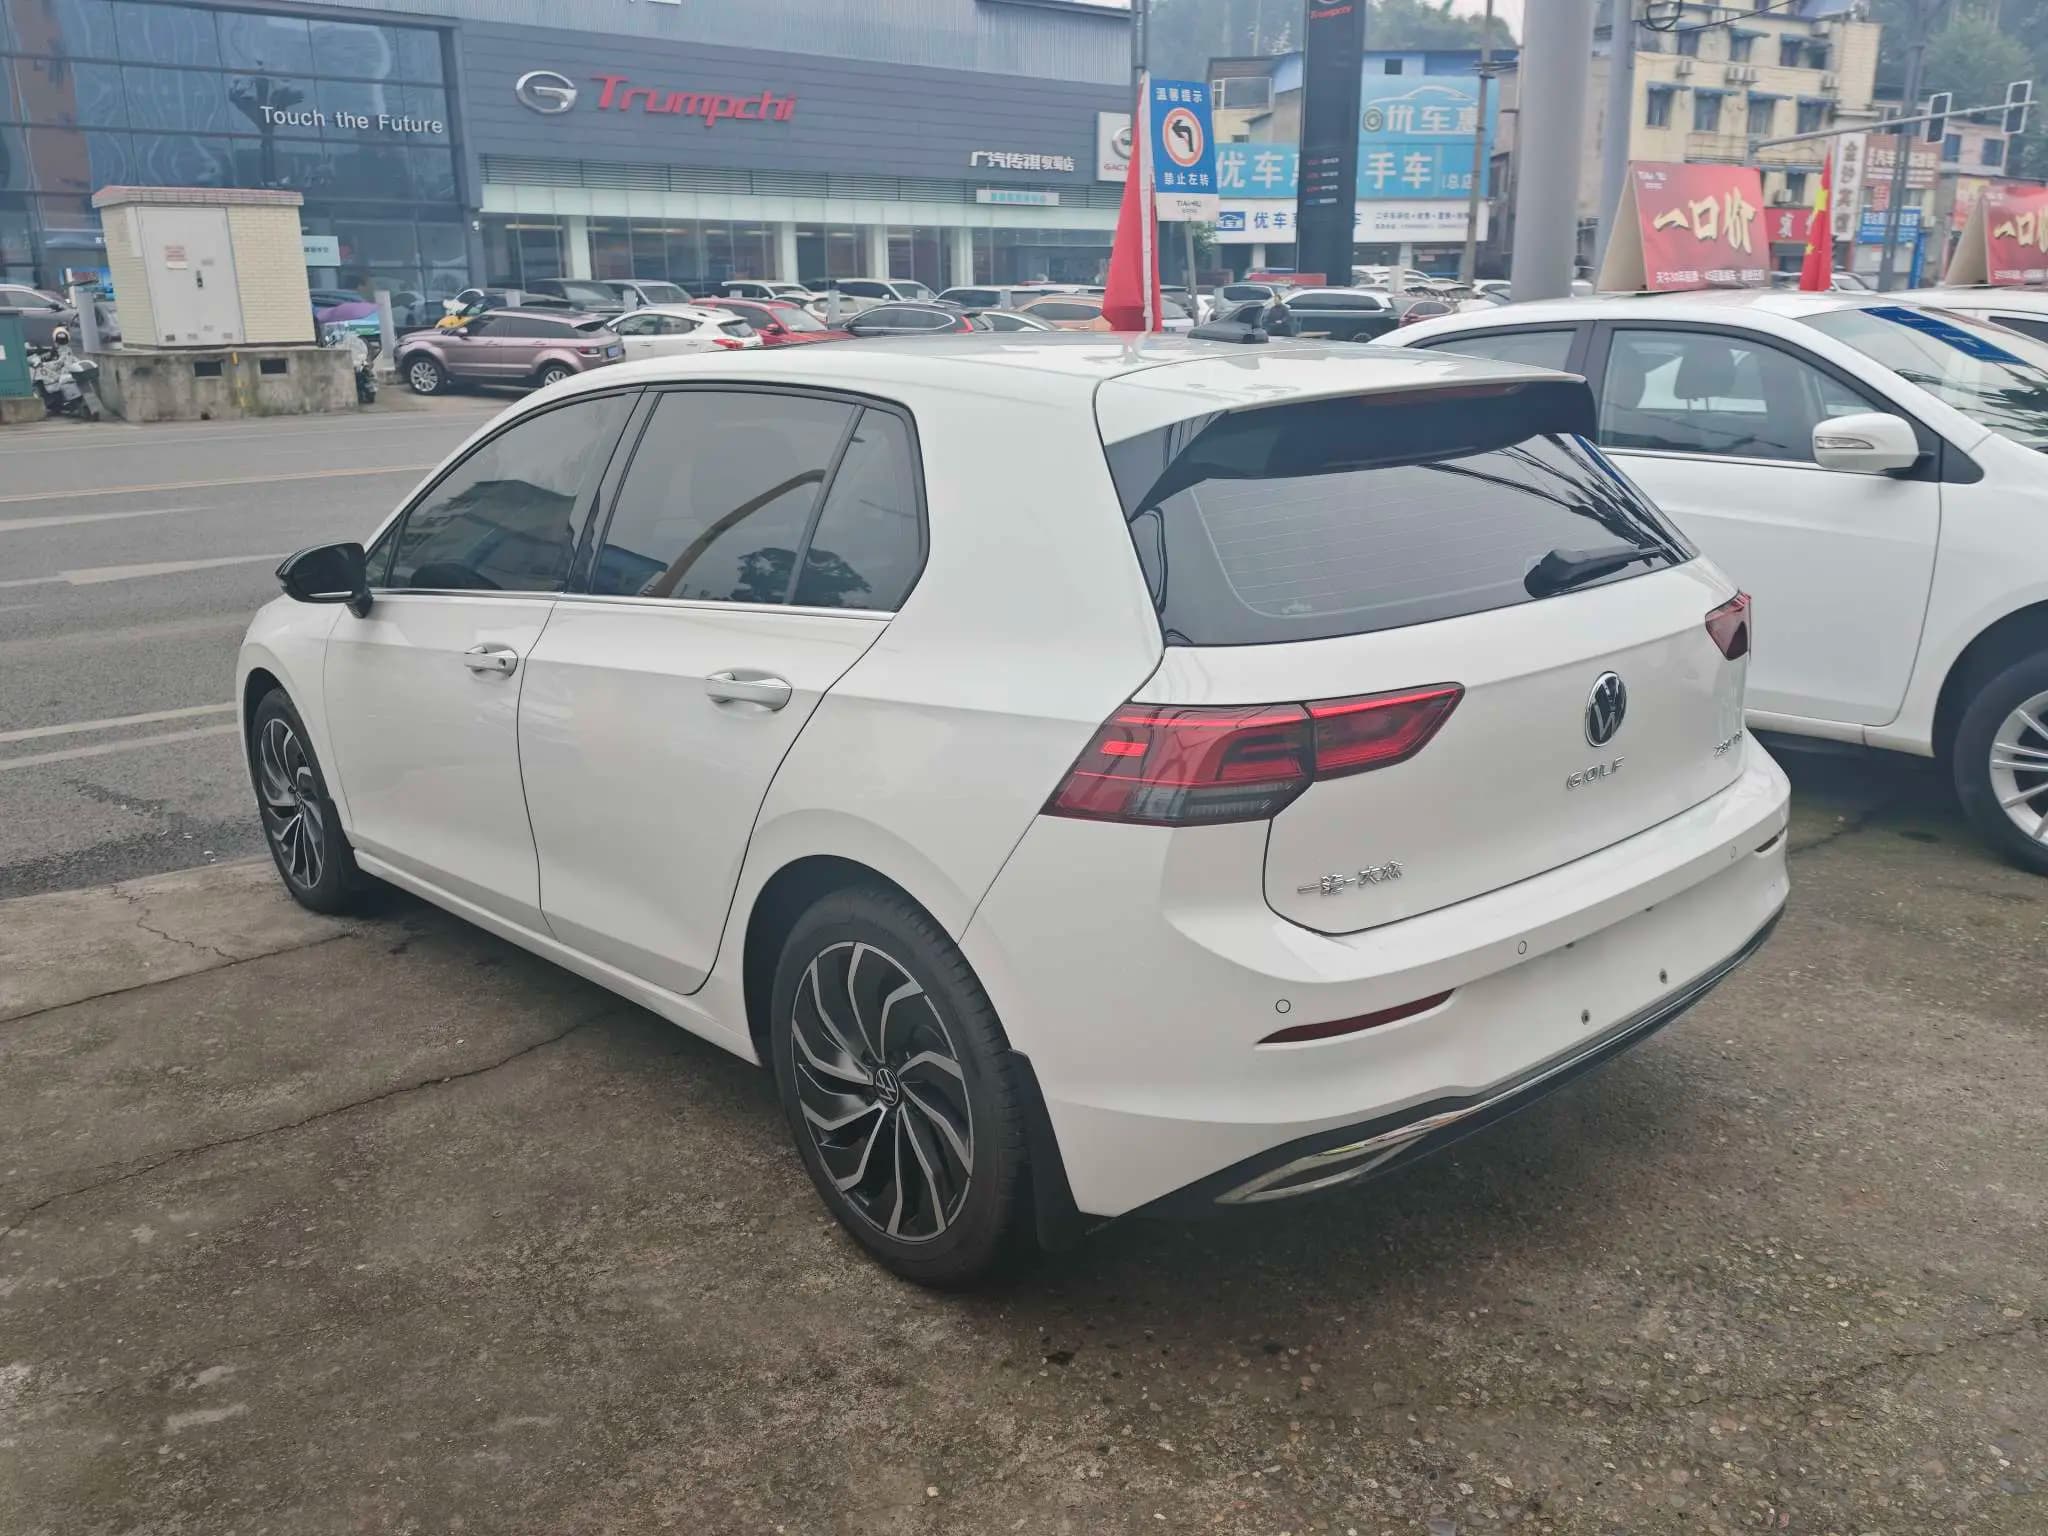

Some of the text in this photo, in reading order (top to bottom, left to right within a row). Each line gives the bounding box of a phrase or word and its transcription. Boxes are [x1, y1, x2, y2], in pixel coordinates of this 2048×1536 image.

[590, 73, 796, 128] Trumpchi
[259, 105, 444, 134] Touch the Future
[1164, 172, 1209, 187] 禁止左转
[1653, 186, 1756, 254] 一口价
[1566, 756, 1624, 789] GOLF
